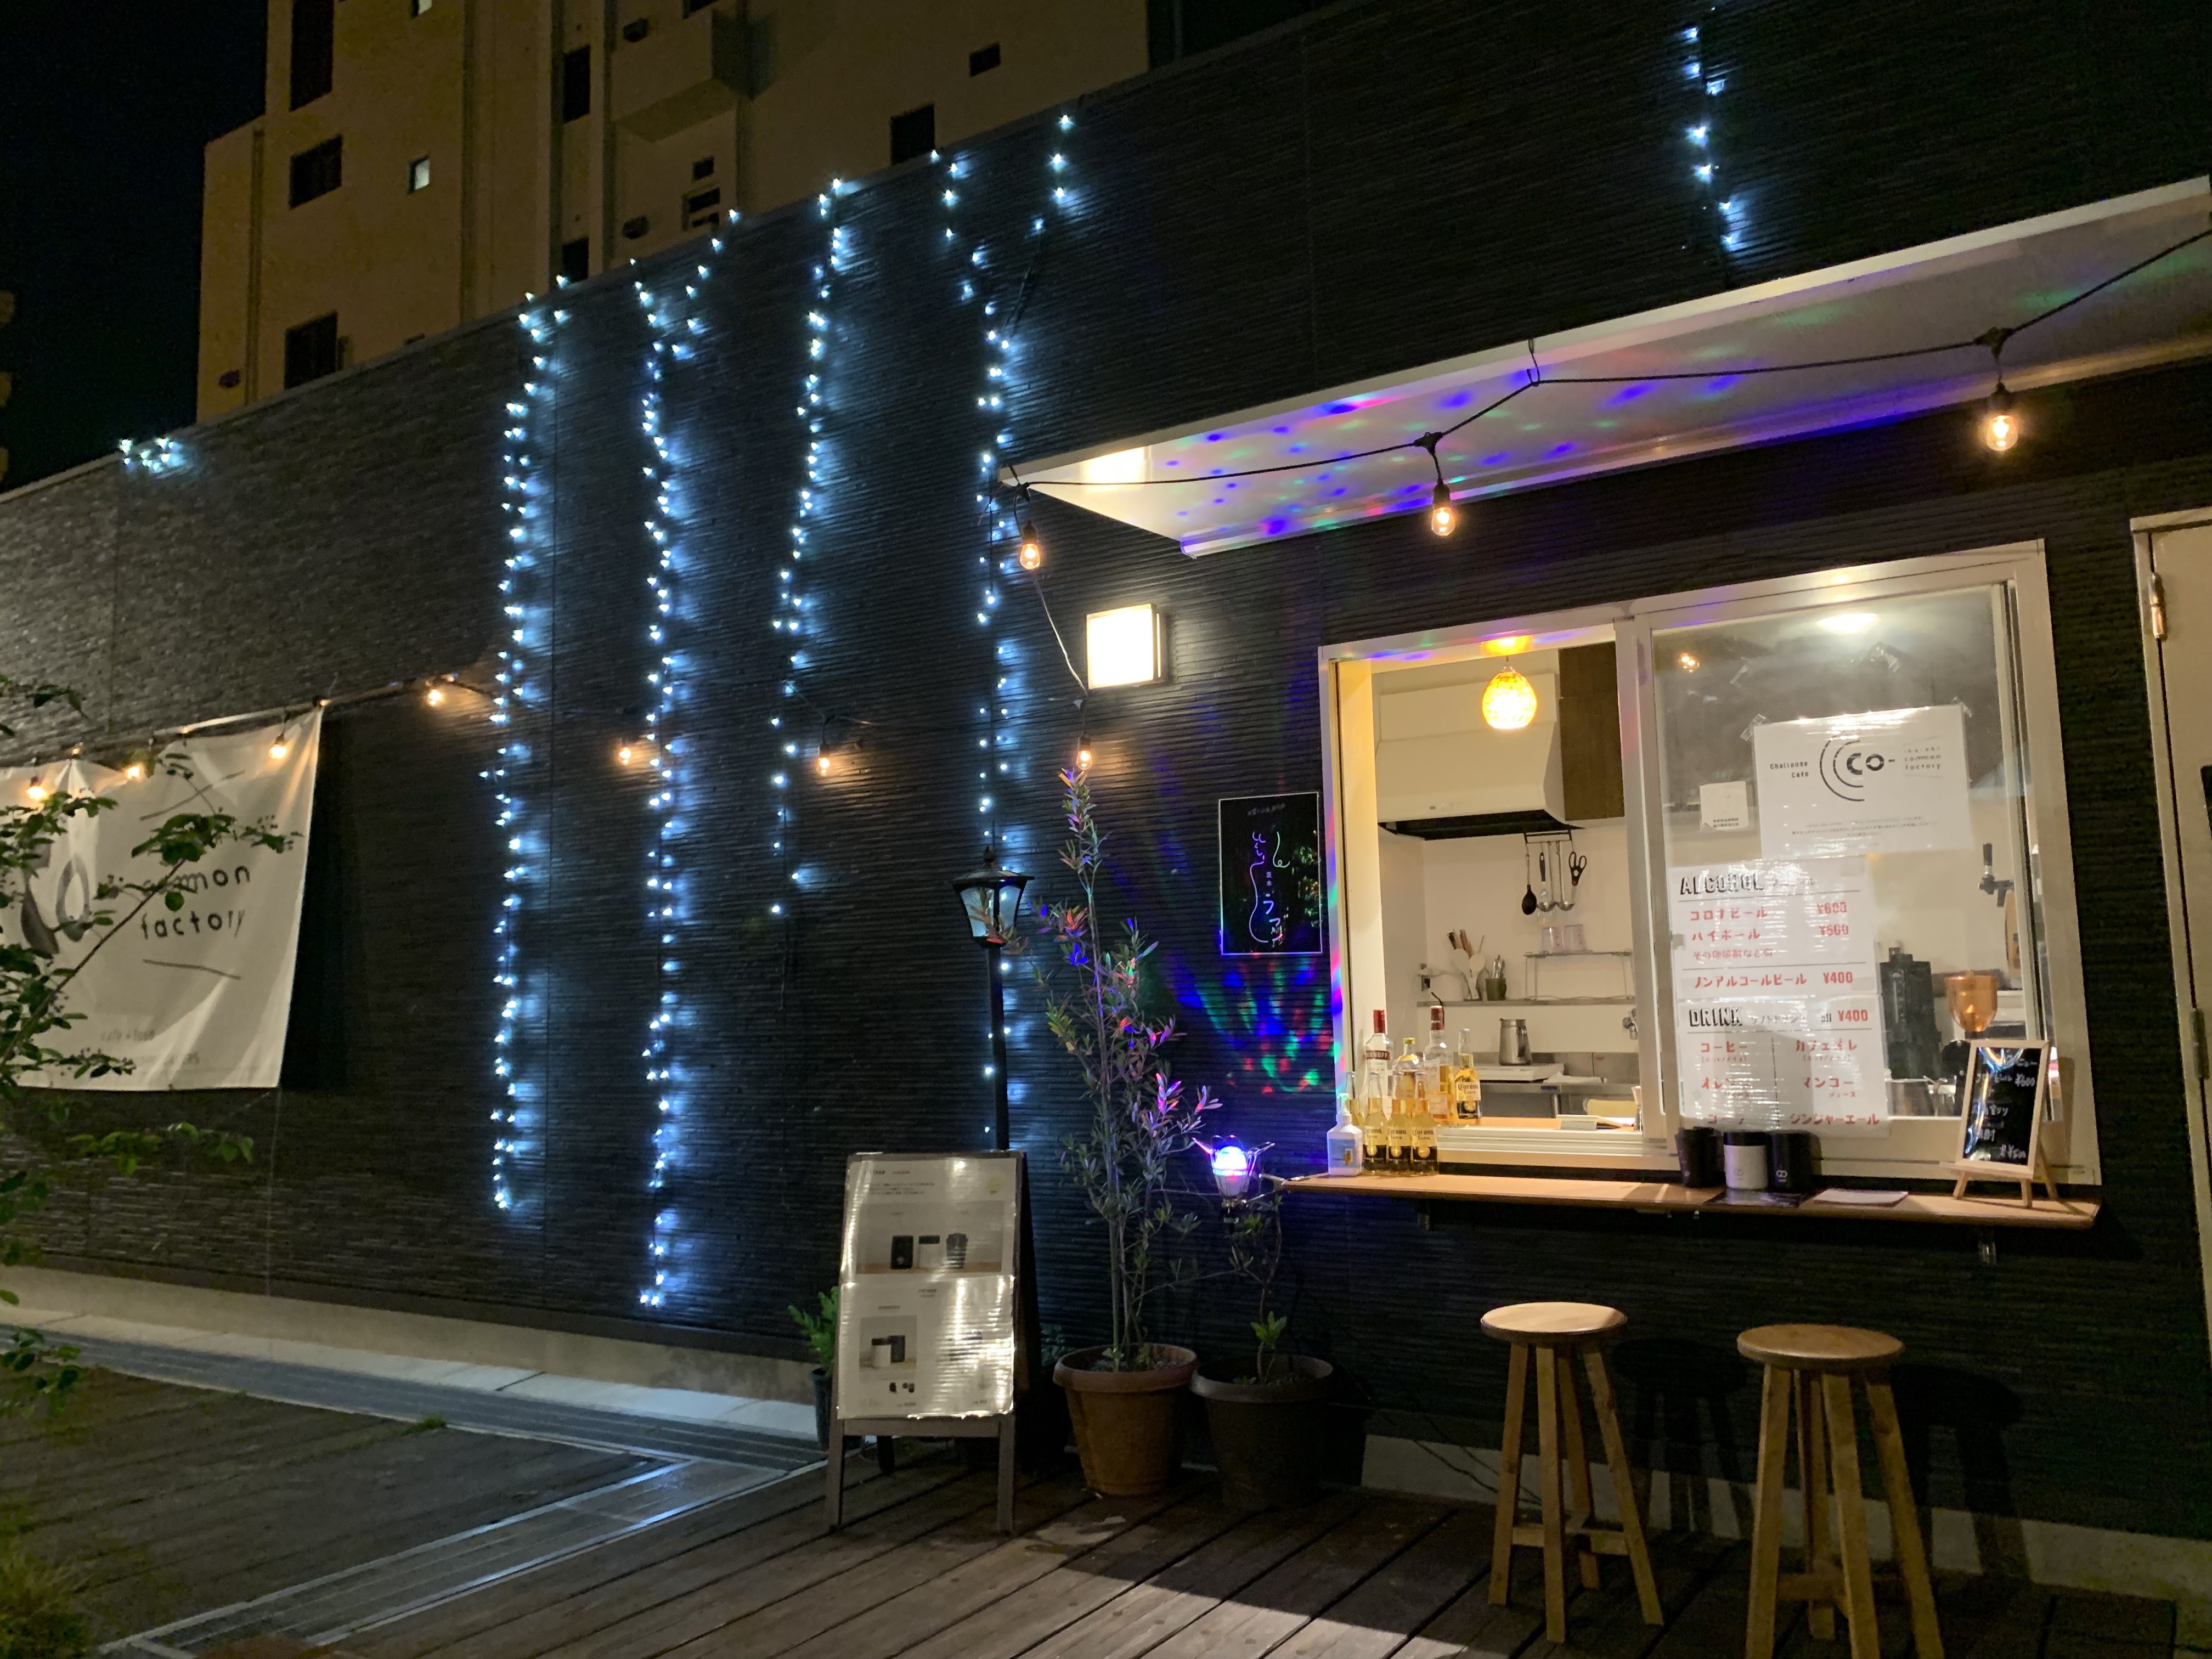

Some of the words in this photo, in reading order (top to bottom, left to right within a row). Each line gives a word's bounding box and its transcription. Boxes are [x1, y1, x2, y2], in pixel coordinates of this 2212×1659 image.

[1770, 760, 1808, 770] Challenge
[1680, 872, 1764, 895] ALCOHOL
[1690, 907, 1768, 921] コロナビール
[141, 909, 245, 940] factory
[1692, 928, 1760, 941] ハイボール
[1695, 973, 1807, 989] ノンアルコールビール
[1822, 971, 1853, 984] ¥400
[1689, 1006, 1742, 1027] DRINK
[1821, 1013, 1832, 1023] all
[1838, 1009, 1869, 1022] ¥400
[1701, 1041, 1748, 1053] コーヒー
[1791, 1113, 1879, 1125] ジンジャーエール
